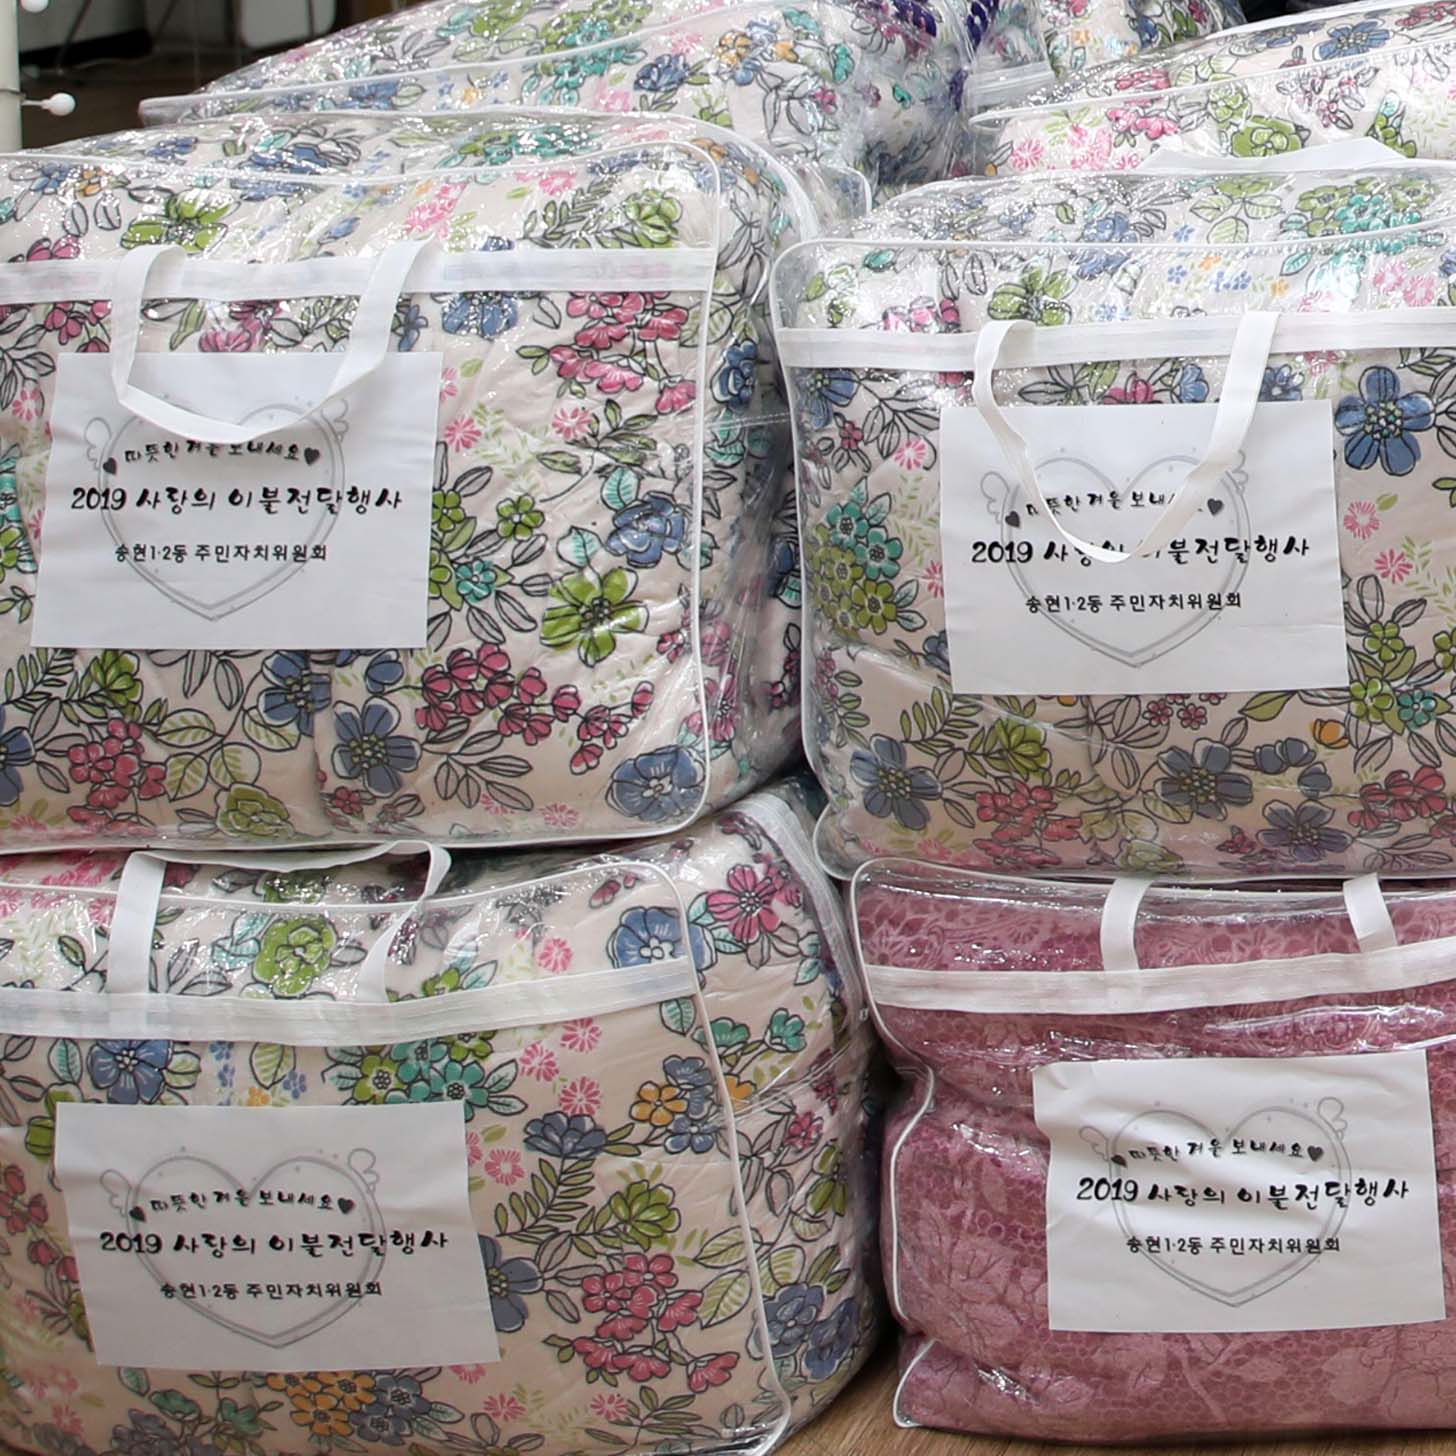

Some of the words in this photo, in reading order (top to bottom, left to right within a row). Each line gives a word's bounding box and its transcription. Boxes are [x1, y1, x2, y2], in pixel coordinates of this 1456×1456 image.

[71, 486, 127, 511] 2019
[135, 486, 216, 515] 사랑의
[227, 485, 402, 515] 이불전달행사
[115, 543, 187, 564] 송현1·2동
[195, 544, 326, 564] 주민자치위원회
[971, 540, 1034, 564] 2019
[1025, 595, 1103, 614] 송현1·2동
[1109, 592, 1241, 613] 주민자치위원회
[1127, 1145, 1179, 1162] 따뜻한
[1232, 1139, 1303, 1158] 보내세요
[149, 1192, 207, 1212] 따뜻한
[259, 1190, 332, 1210] 보내세요
[1076, 1177, 1139, 1203] 2019
[1147, 1183, 1225, 1208] 사랑의
[1236, 1178, 1409, 1211] 이불전달행사
[99, 1231, 163, 1255] 2019
[172, 1233, 256, 1258] 사랑의
[268, 1230, 448, 1258] 이불전달행사
[1126, 1235, 1203, 1255] 송현1·2동
[1210, 1237, 1340, 1256] 주민자치위원회
[160, 1282, 239, 1301] 송현1·2동
[246, 1281, 382, 1300] 주민자치위원회
